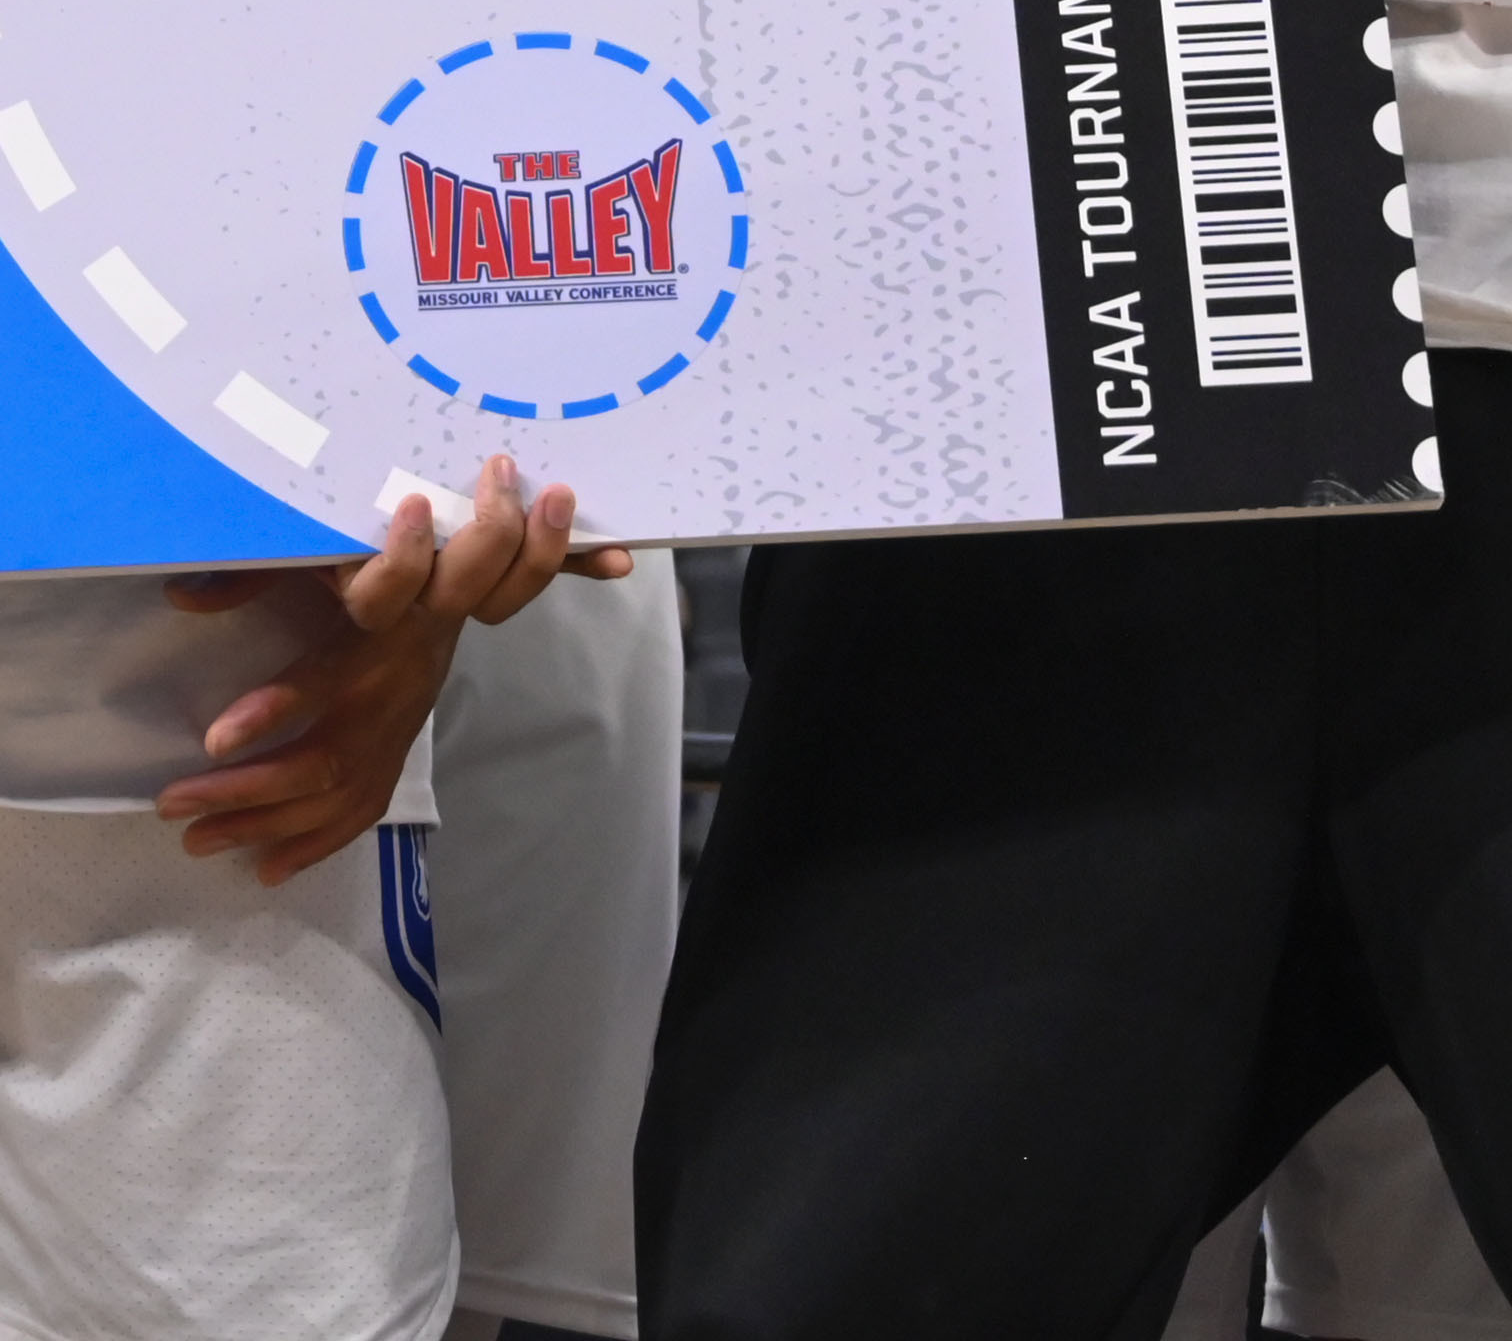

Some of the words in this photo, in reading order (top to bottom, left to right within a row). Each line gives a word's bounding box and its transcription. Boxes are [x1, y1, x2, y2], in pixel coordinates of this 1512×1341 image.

[493, 150, 581, 183] THE
[399, 138, 683, 286] VALLEY
[417, 291, 499, 308] MISSOURI
[505, 288, 564, 303] VALLEY
[569, 283, 677, 301] CONFERENCE
[1087, 290, 1159, 468] NCAA
